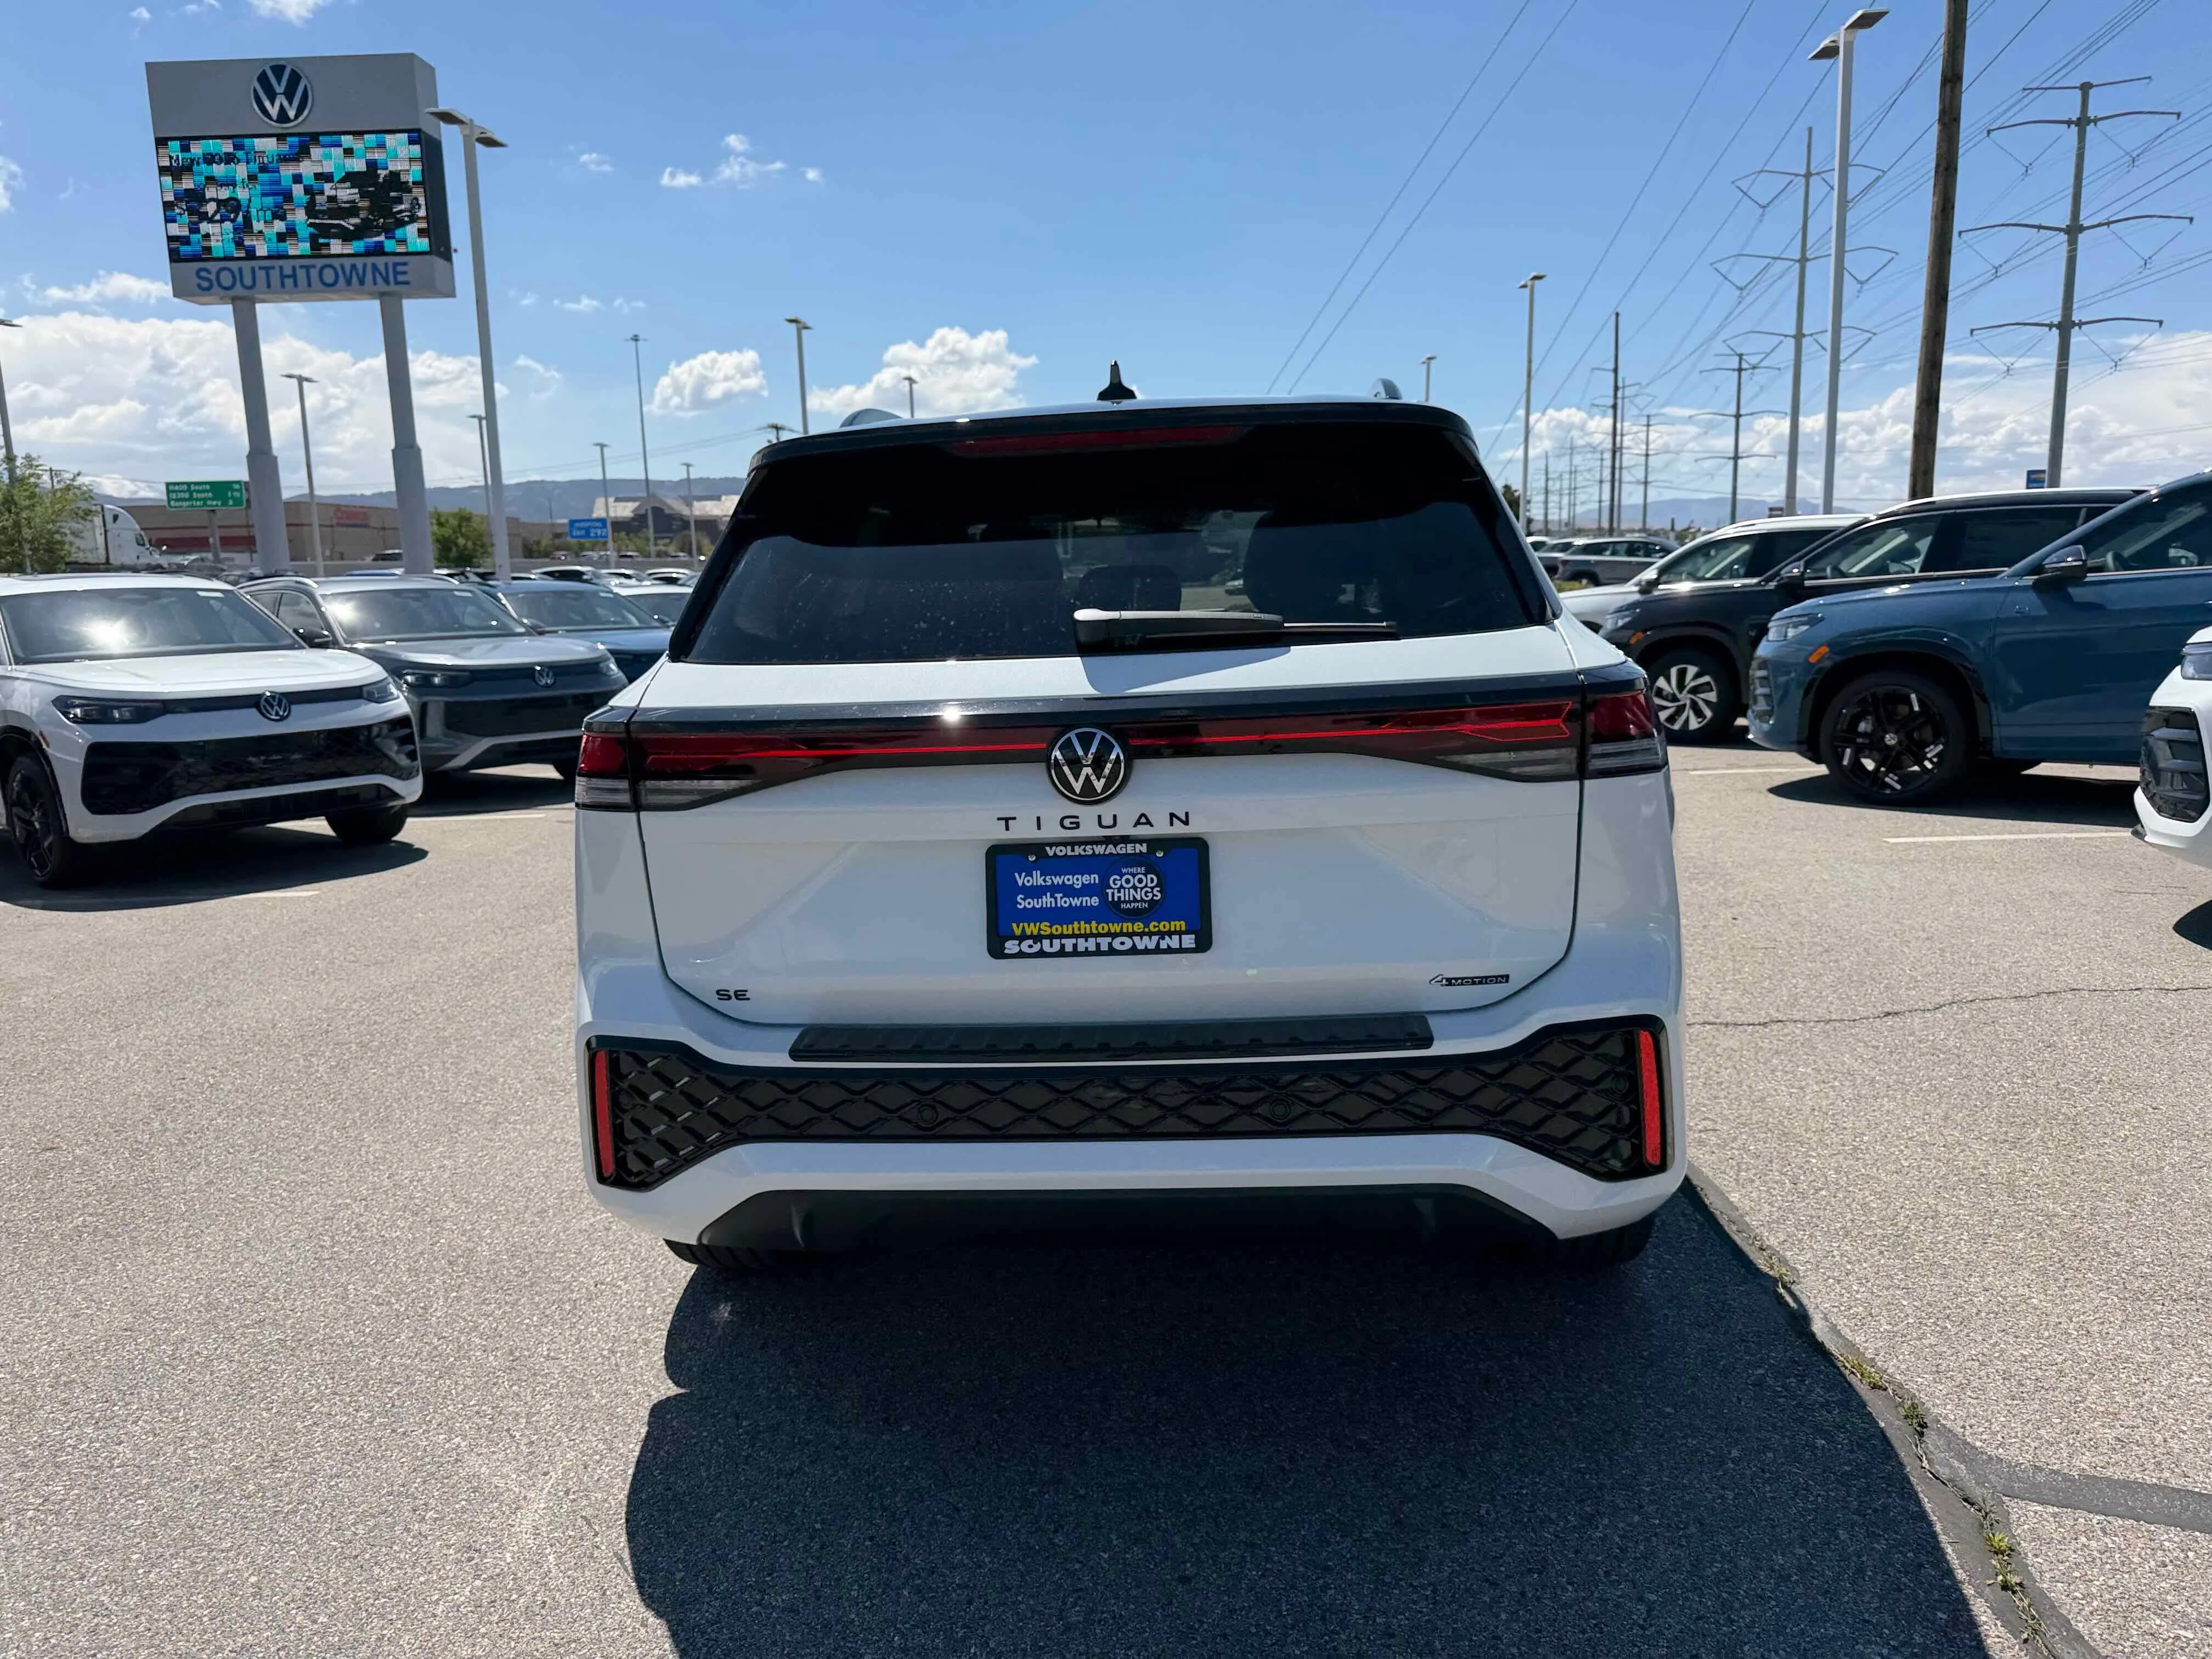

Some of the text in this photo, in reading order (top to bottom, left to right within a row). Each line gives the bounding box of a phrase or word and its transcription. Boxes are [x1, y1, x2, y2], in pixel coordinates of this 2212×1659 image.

[251, 61, 313, 128] VW
[195, 261, 410, 291] SOUTHTOWNE
[1051, 727, 1125, 801] VW
[997, 811, 1190, 831] TIGUAN
[1045, 843, 1148, 856] VOLKSWAGEN
[1014, 871, 1099, 888] Volkswagen
[1109, 874, 1158, 888] GOOD
[1017, 892, 1099, 909] SouthTowne
[1106, 887, 1161, 901] THINGS
[1012, 919, 1186, 936] VWSouthtowne.com
[1004, 934, 1196, 954] SOUTHTOWNE
[1429, 974, 1508, 986] 4MOTION
[715, 989, 751, 1001] SE
